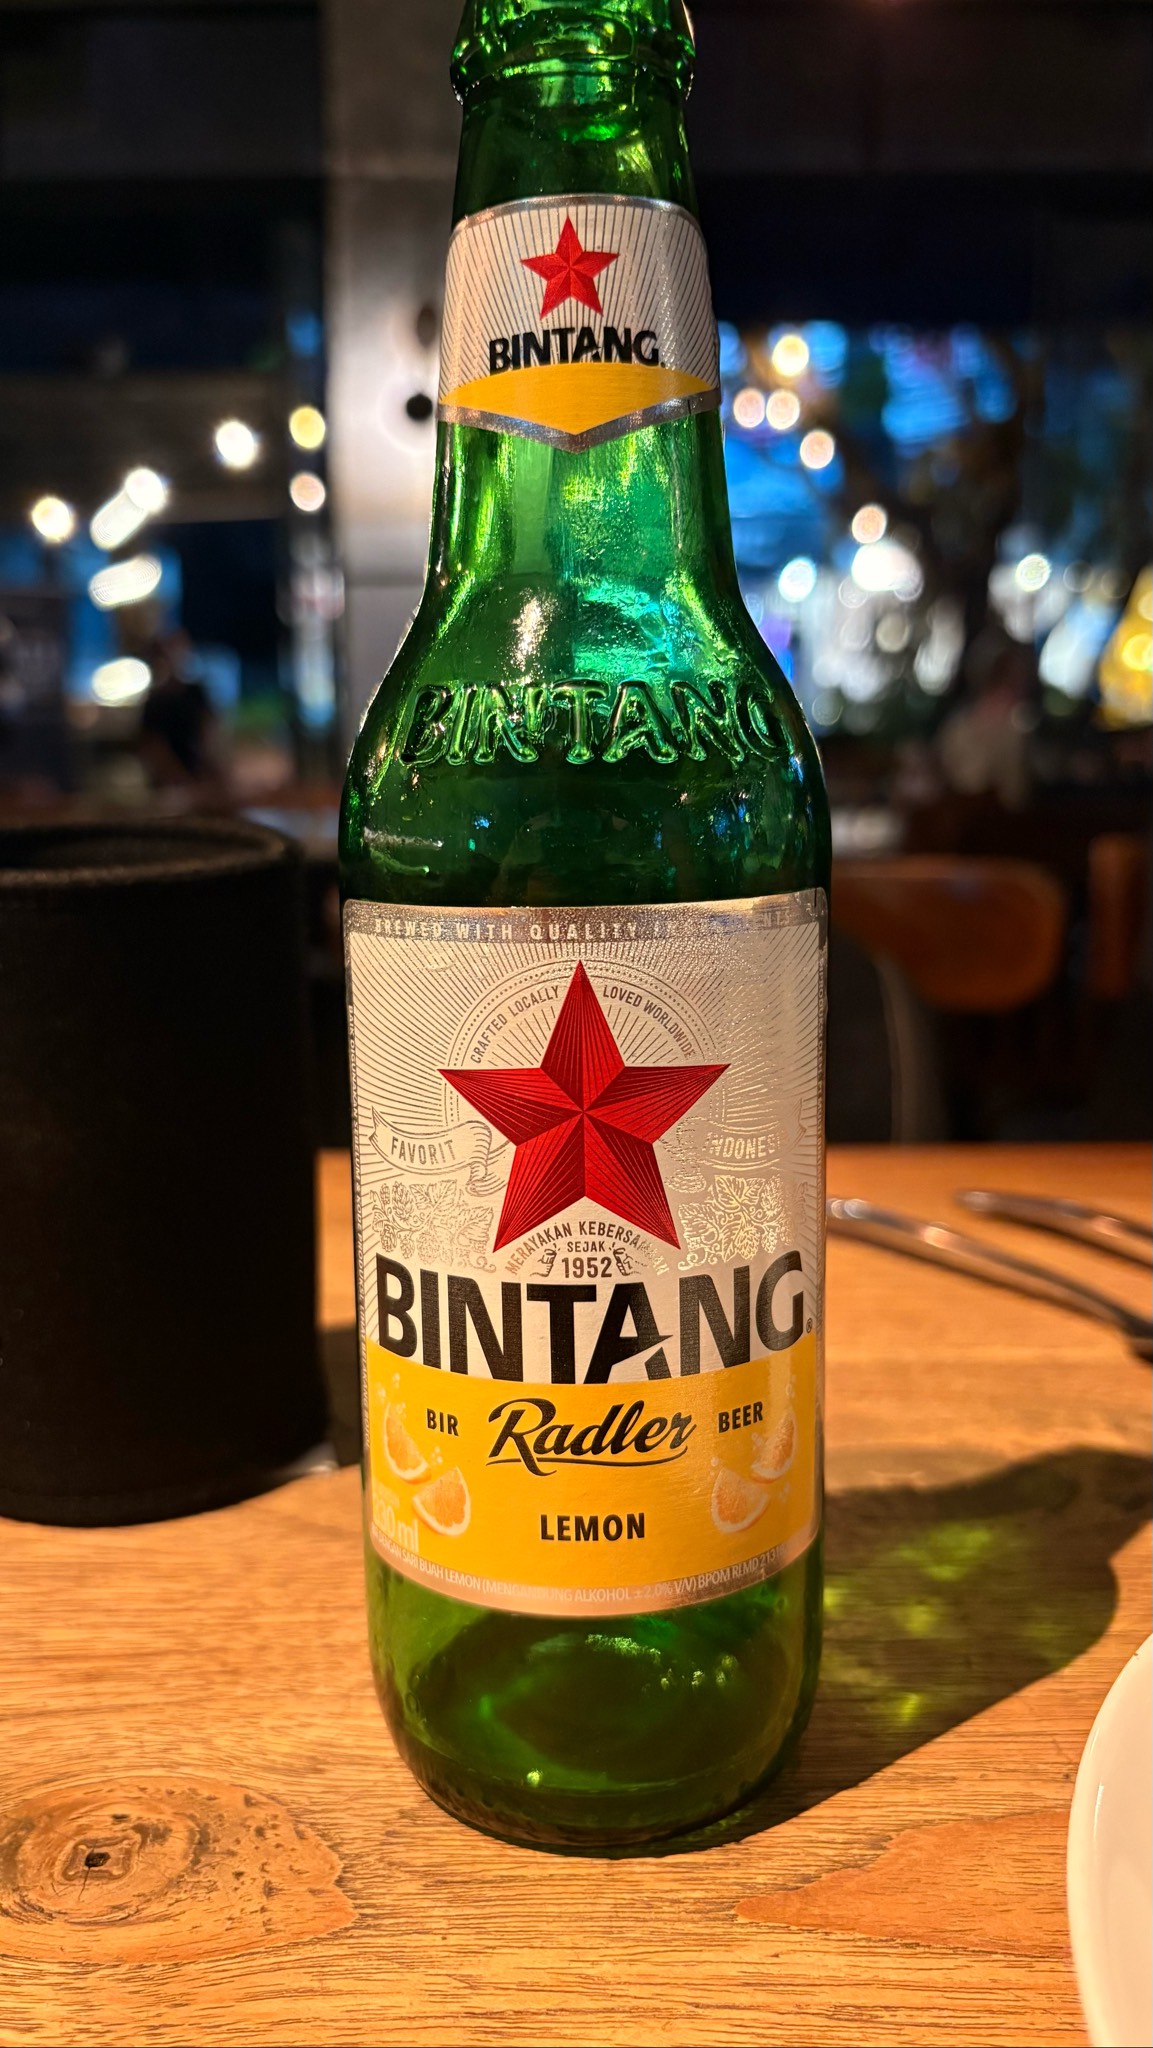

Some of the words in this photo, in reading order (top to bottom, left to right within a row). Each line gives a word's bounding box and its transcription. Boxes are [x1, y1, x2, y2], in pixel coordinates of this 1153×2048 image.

[489, 326, 659, 376] BINTANG
[400, 678, 795, 767] BINTANG
[375, 918, 442, 938] BREWED
[456, 922, 513, 940] WITH
[530, 922, 637, 940] QUALITY
[470, 1013, 508, 1064] CRAFTED
[507, 985, 559, 1017] LOCALLY
[603, 984, 643, 1007] LOVED
[643, 1000, 696, 1060] WORLDWIDE
[391, 1136, 456, 1165] FAVORIT
[505, 1222, 572, 1276] MERAYAKAN
[561, 1256, 613, 1278] 1952
[567, 1241, 606, 1253] SEJAK
[376, 1250, 805, 1385] BINTANG
[427, 1408, 459, 1436] BIR
[485, 1397, 697, 1477] Radler
[718, 1401, 763, 1434] BEER
[541, 1512, 645, 1542] LEMON
[403, 1548, 419, 1568] SARI
[419, 1558, 444, 1579] BUAH
[445, 1568, 481, 1591] LEMON
[574, 1587, 631, 1602] ALKOHOL
[698, 1567, 731, 1589] BPOM
